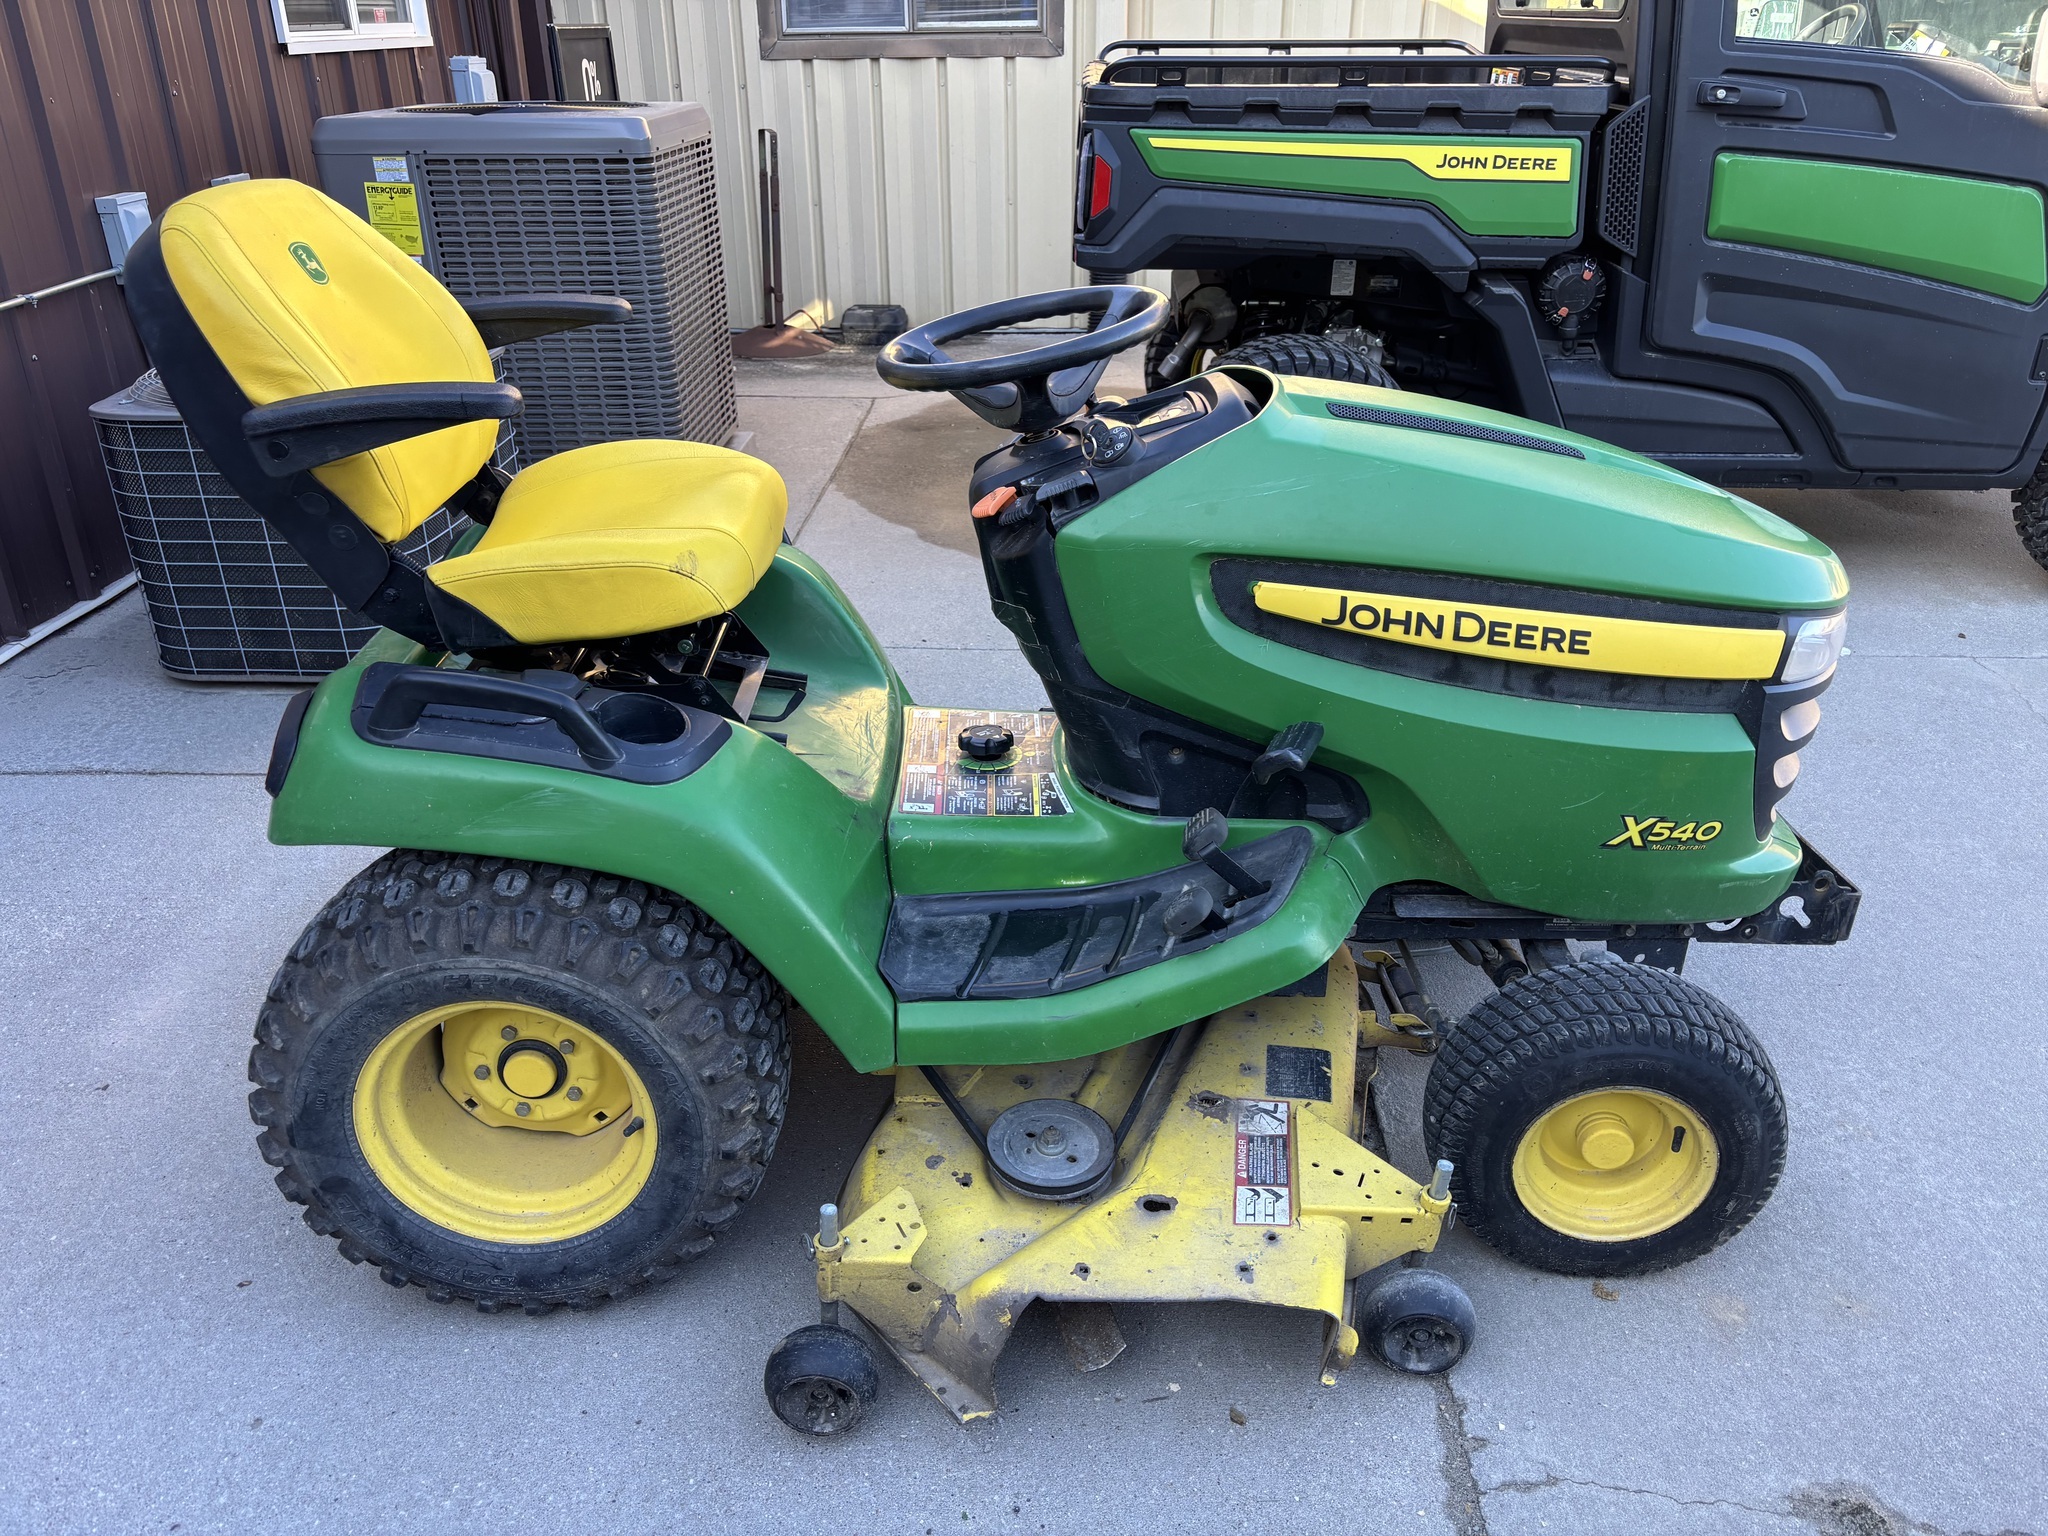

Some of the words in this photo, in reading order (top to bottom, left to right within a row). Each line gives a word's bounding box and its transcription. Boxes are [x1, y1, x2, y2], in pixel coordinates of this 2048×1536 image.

[1436, 154, 1489, 169] JOHN
[1492, 155, 1558, 171] DEERE
[366, 186, 413, 197] ENERGYGUIDE
[1321, 596, 1445, 639] JOHN
[1452, 610, 1592, 656] DEERE
[1603, 814, 1723, 849] X540
[1651, 843, 1707, 851] Multi-Terrain
[1237, 1139, 1247, 1170] DANGER
